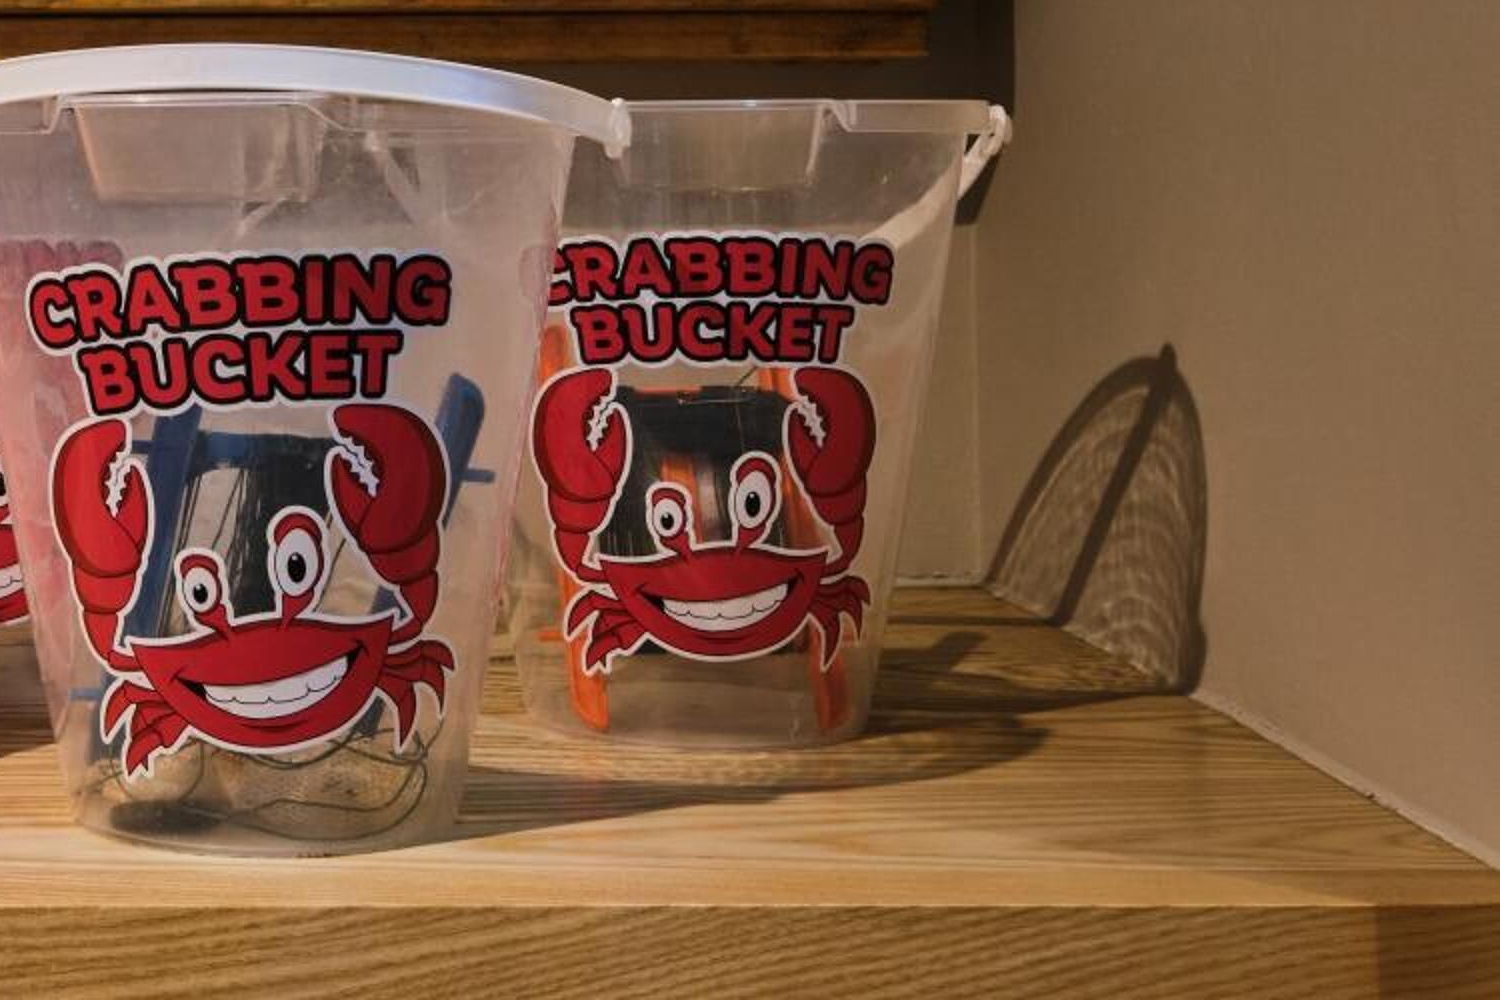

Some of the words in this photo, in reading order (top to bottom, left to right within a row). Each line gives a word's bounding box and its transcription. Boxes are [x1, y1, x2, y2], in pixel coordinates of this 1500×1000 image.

[29, 254, 452, 348] CRABBING
[570, 302, 854, 364] BUCKET
[78, 330, 402, 415] BUCKET
